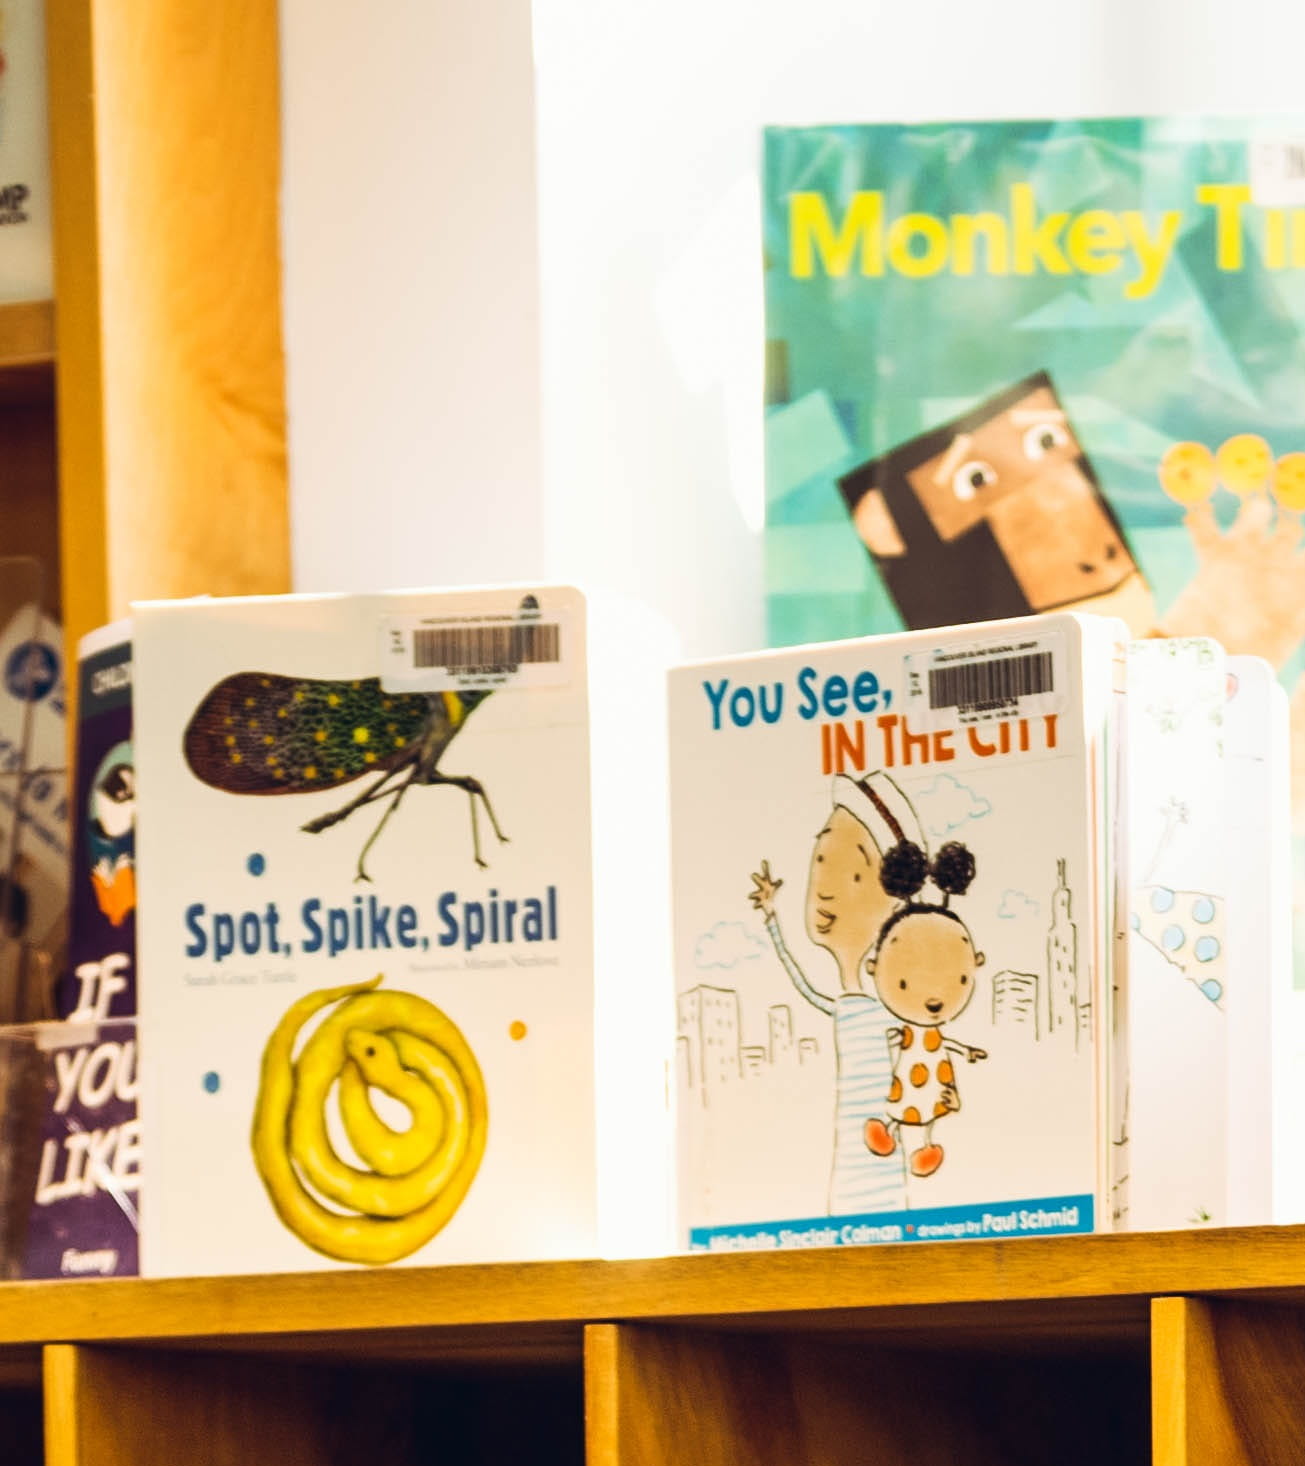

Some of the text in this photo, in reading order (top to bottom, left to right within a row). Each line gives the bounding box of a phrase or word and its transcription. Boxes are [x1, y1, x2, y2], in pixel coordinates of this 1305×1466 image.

[789, 183, 1182, 299] Monkey
[703, 677, 783, 730] You
[798, 667, 892, 720] See,
[821, 720, 866, 775] IN
[185, 885, 558, 964] Spot, Spike, Spiral
[68, 954, 128, 1023] IF
[52, 1039, 139, 1114] YOU
[983, 1206, 1078, 1233] Paul Schmid
